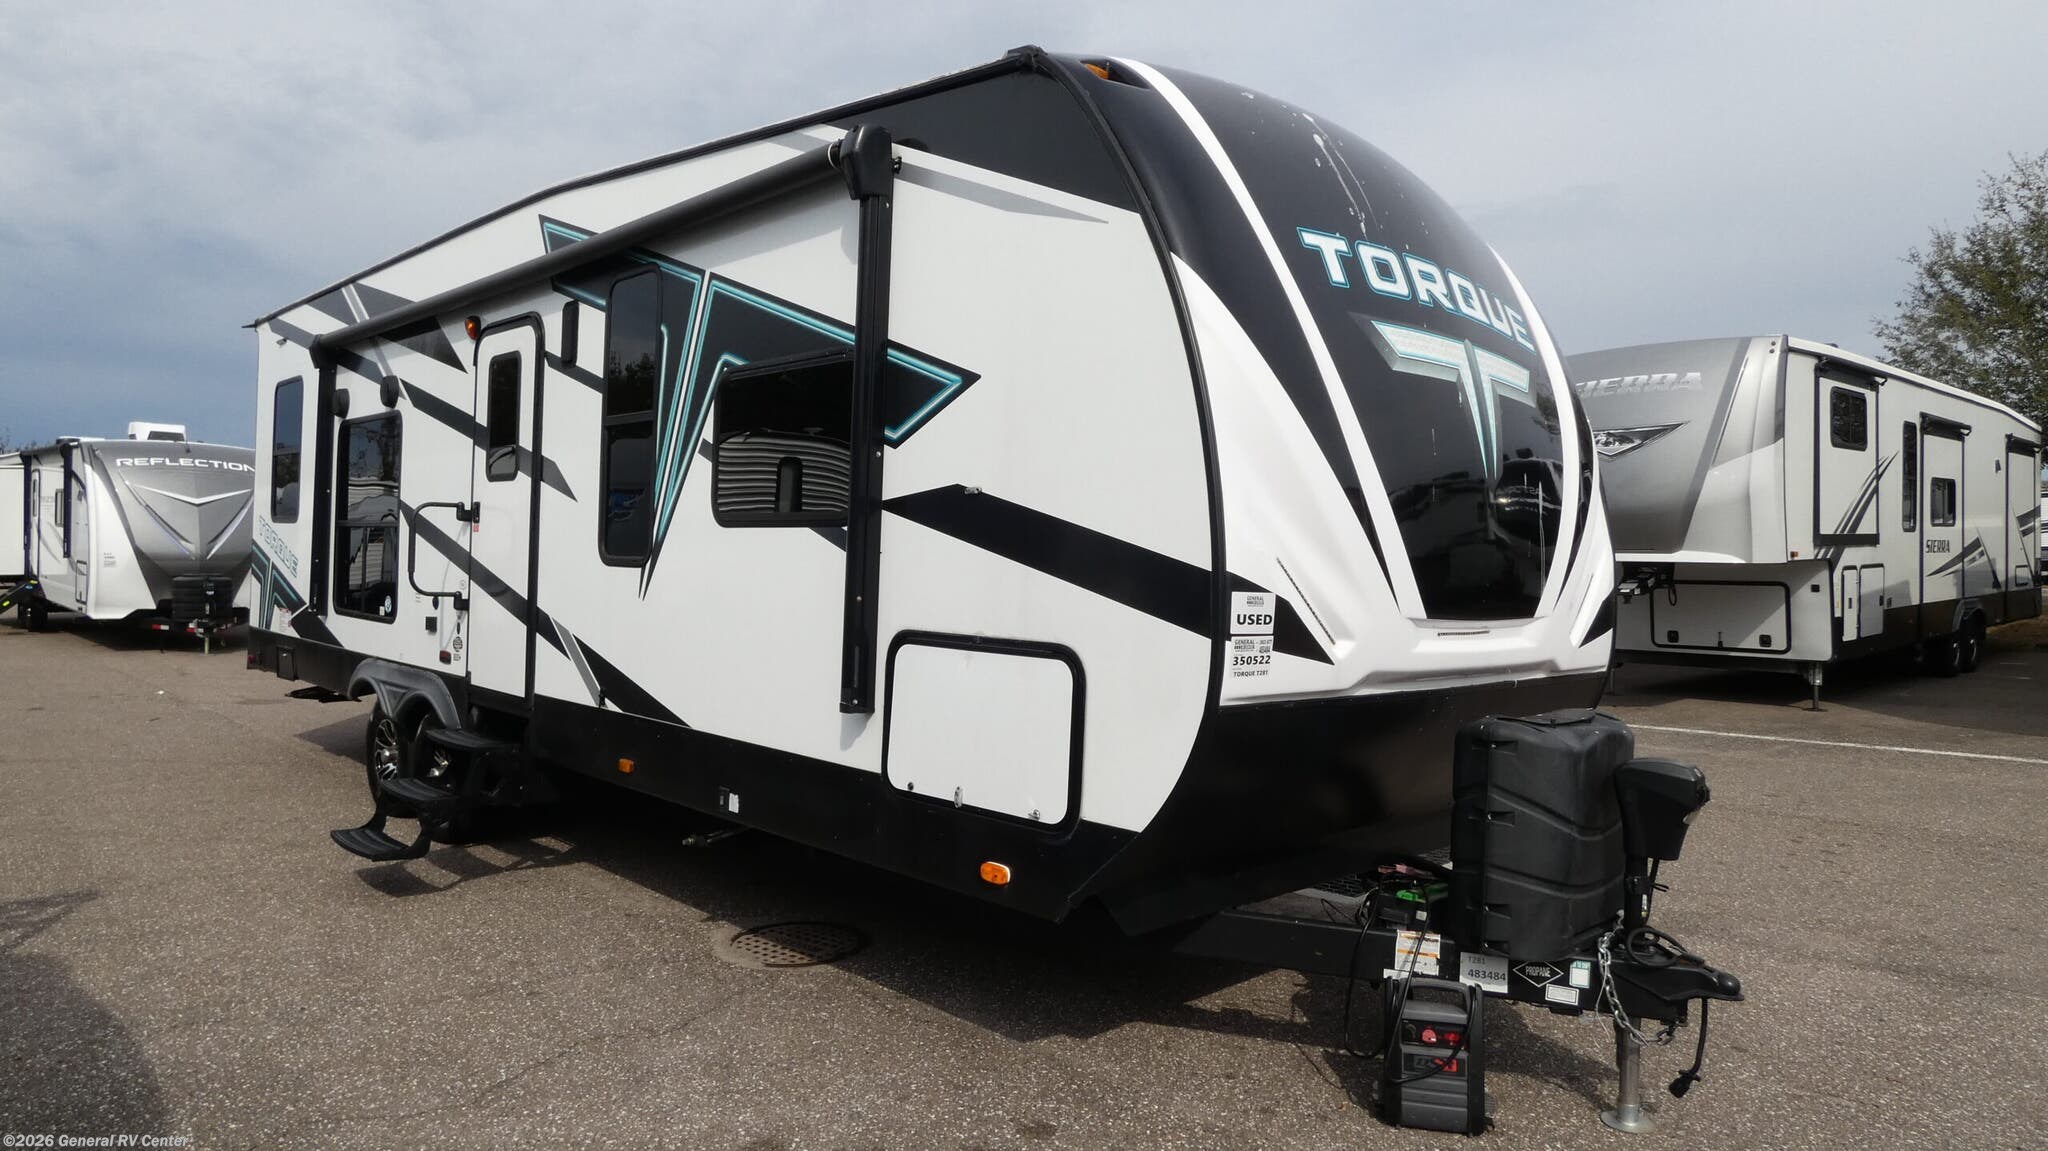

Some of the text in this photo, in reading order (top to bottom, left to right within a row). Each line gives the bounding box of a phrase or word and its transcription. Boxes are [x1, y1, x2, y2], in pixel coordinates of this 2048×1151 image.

[1296, 226, 1537, 355] TORQUE
[115, 457, 256, 472] REFLECTION
[1925, 539, 1951, 554] SIERRA
[1237, 613, 1273, 625] USED
[1233, 655, 1271, 666] 350522
[1468, 968, 1506, 981] 483484
[1526, 966, 1551, 978] PROPANE
